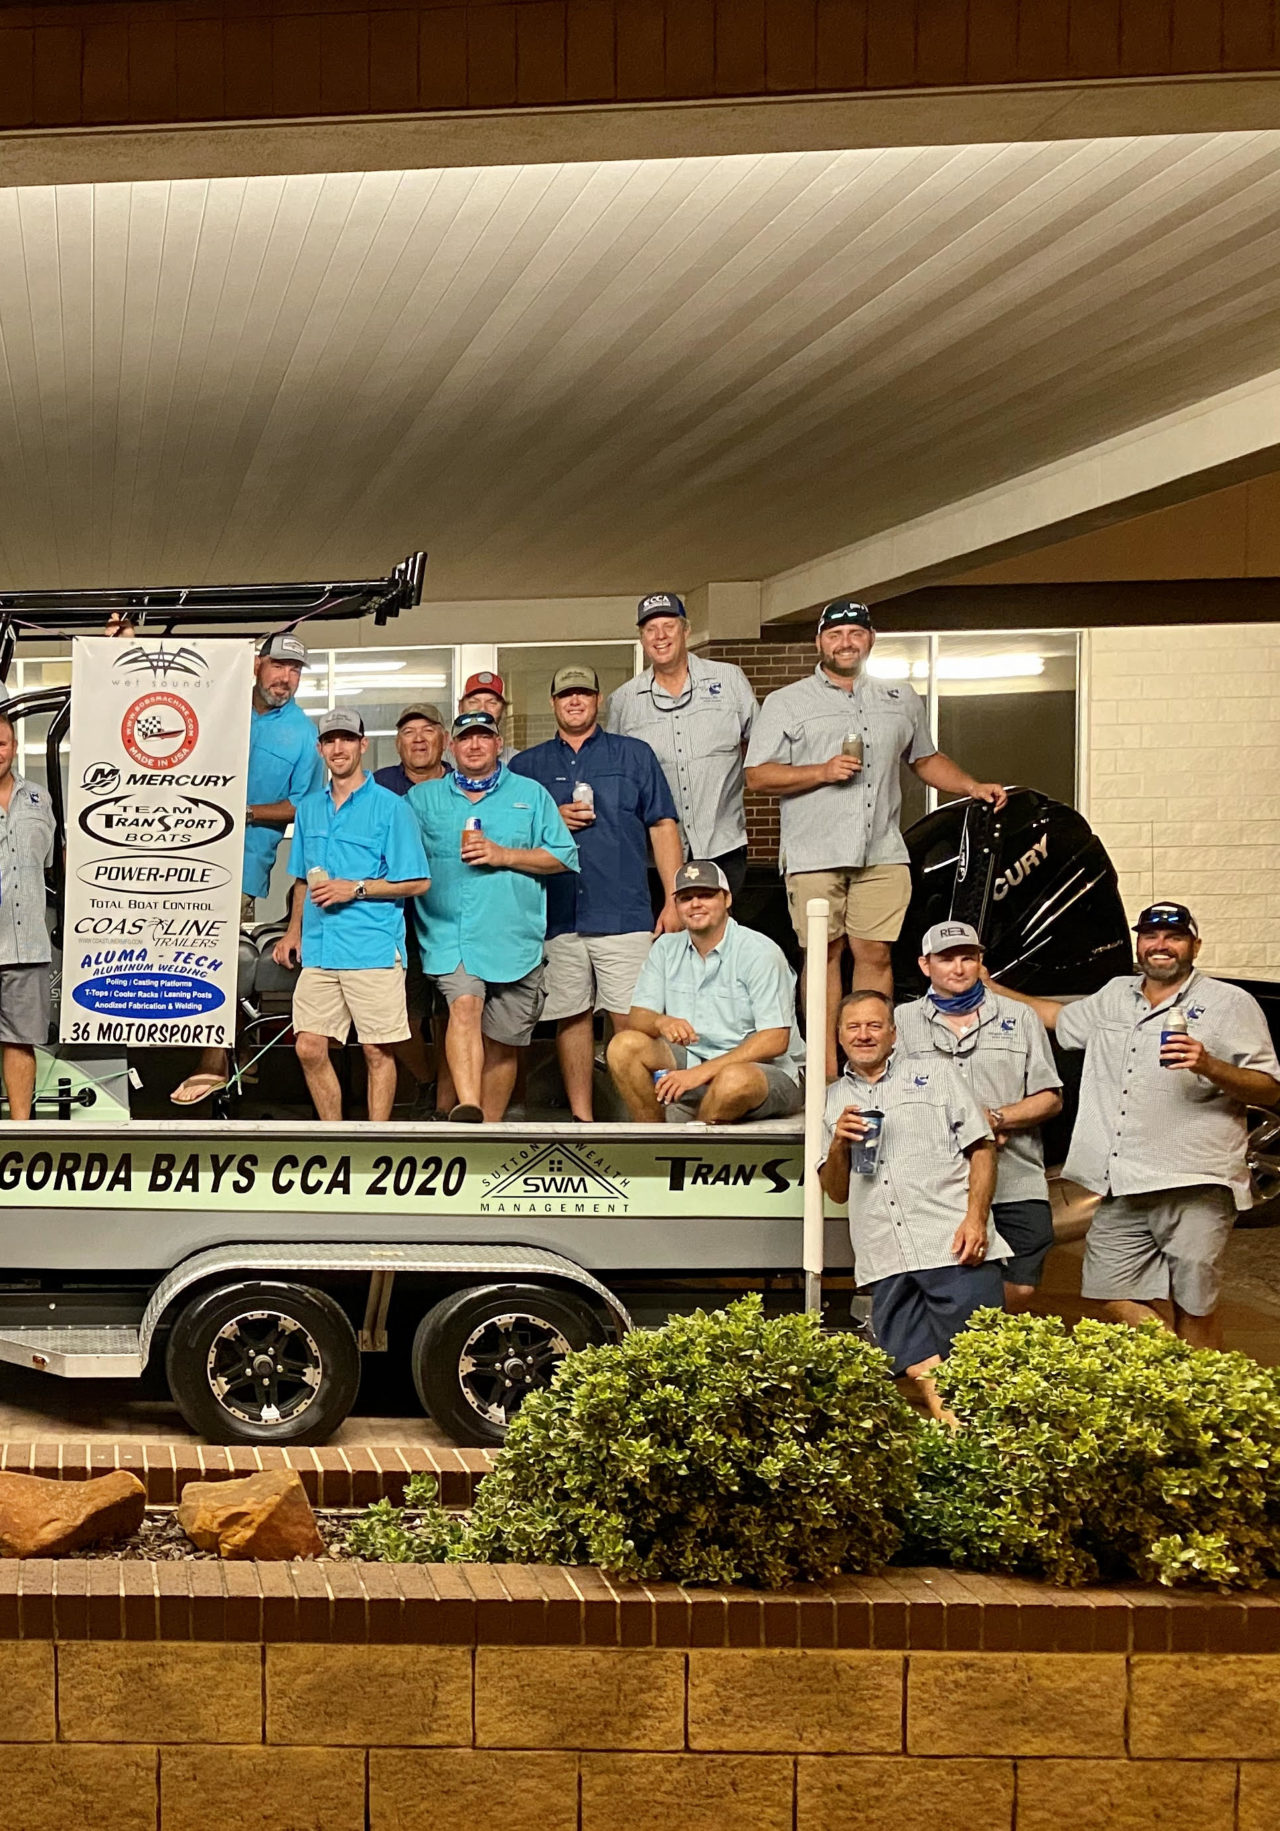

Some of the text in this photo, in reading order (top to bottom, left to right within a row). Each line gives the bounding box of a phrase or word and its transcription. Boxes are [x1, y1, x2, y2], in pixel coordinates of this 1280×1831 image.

[129, 746, 154, 766] MADE
[171, 748, 190, 763] USA
[126, 774, 236, 787] MERCURY
[118, 806, 192, 814] TEAM
[124, 833, 192, 843] BOATS
[94, 866, 212, 883] POWER-POLE
[155, 938, 219, 948] TRAILERS
[81, 948, 148, 969] ALUMA
[173, 951, 223, 972] TECH
[93, 964, 208, 978] ALUMINUM WELDING
[106, 978, 128, 986] Poling
[133, 979, 159, 988] Casting
[85, 989, 109, 997] T-Tops
[164, 992, 191, 1000] Leaning
[128, 1002, 166, 1010] Fabrication
[175, 1003, 202, 1011] Welding
[71, 1022, 225, 1044] 36 MOTORSPORTS
[482, 1143, 631, 1188] SUTTON WEALTH
[148, 1153, 260, 1194] BAYS
[271, 1155, 352, 1195] CCA
[365, 1156, 468, 1196] 2020
[655, 1157, 804, 1193] TRANS
[523, 1177, 588, 1193] SWM
[481, 1203, 629, 1212] MANAGEMENT
